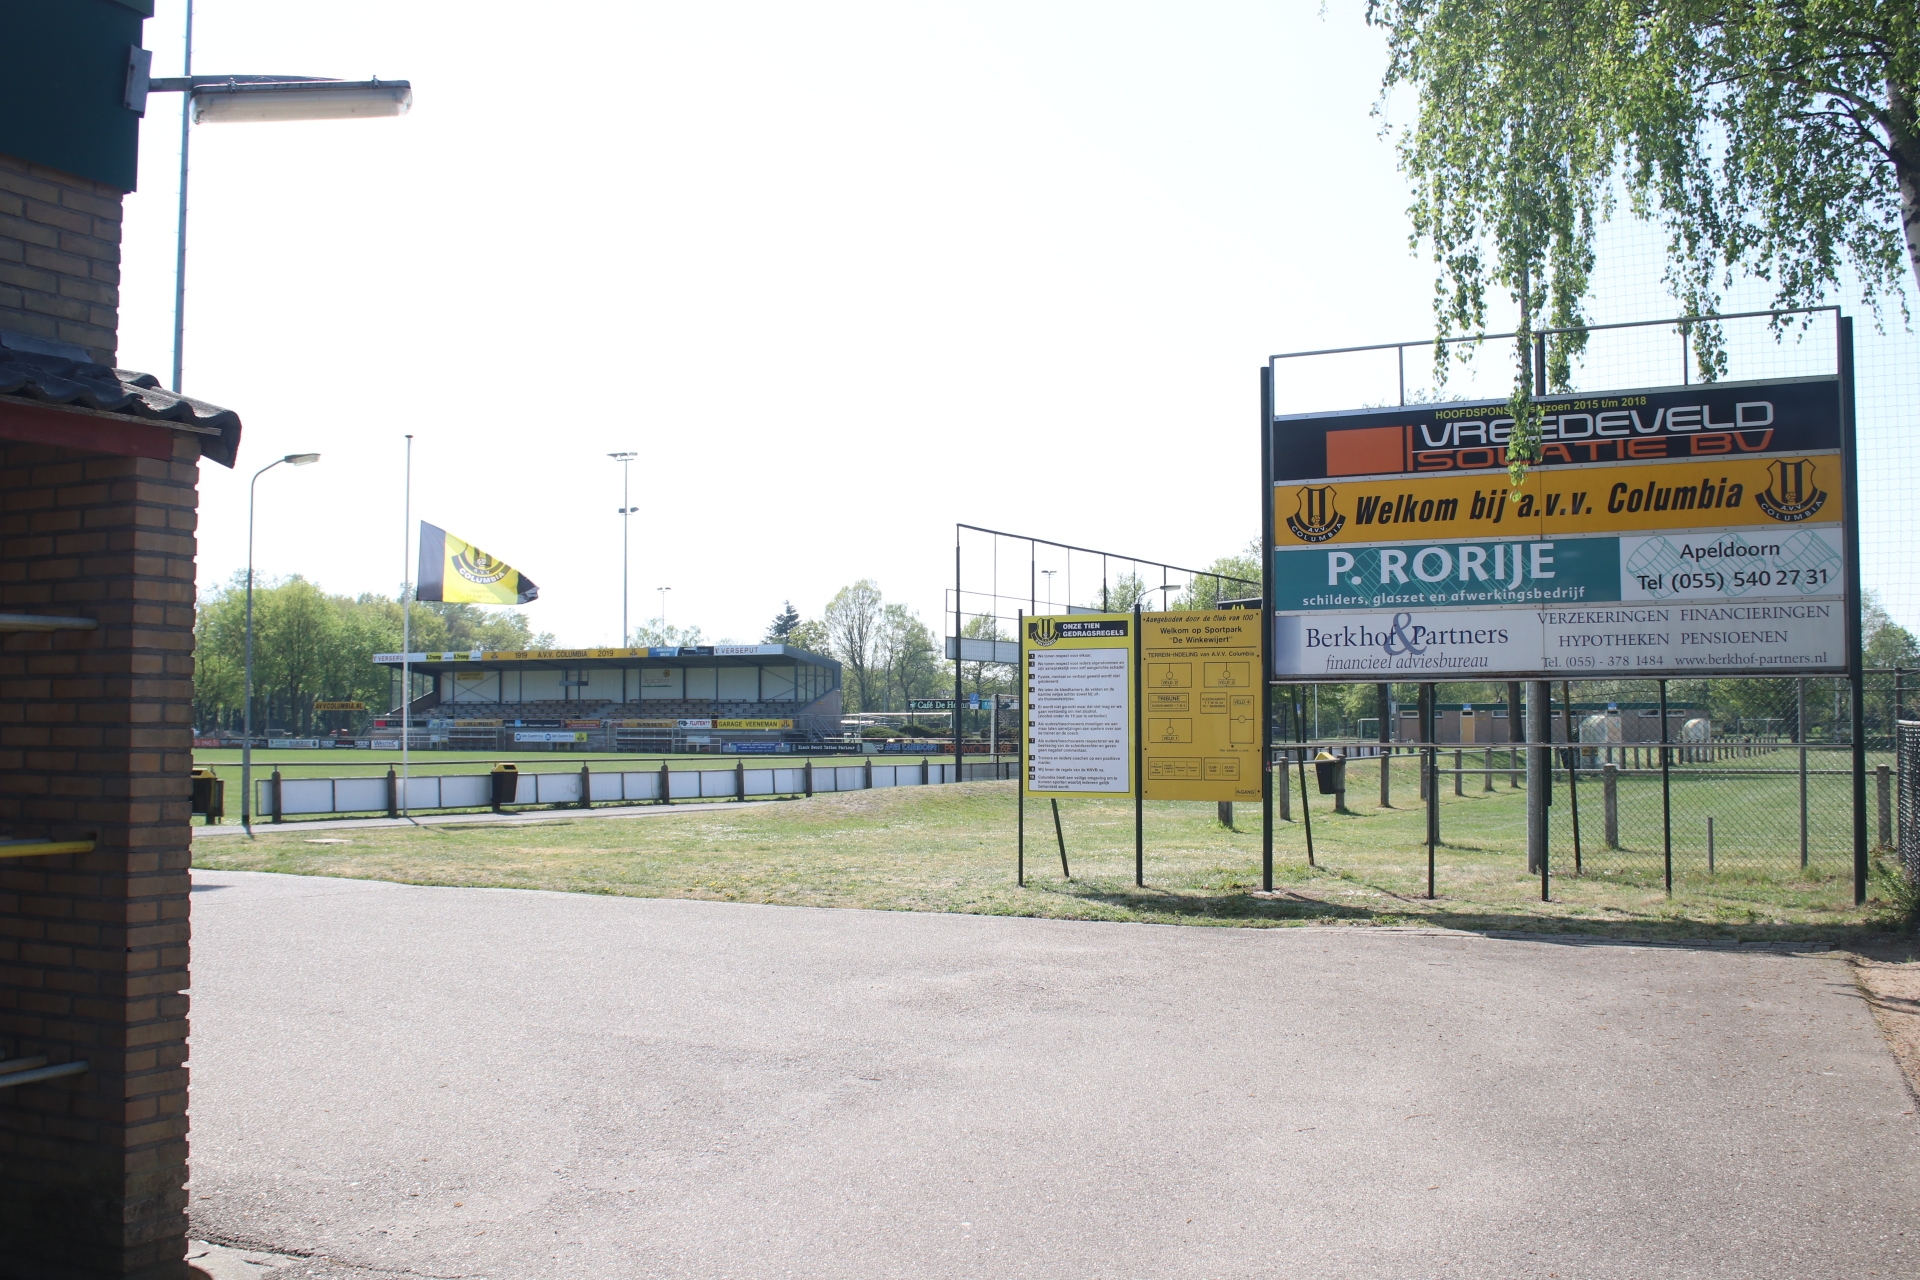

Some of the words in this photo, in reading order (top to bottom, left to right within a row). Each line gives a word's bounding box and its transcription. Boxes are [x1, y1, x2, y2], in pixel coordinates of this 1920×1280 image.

[1435, 407, 1519, 420] HOOFDSPONS
[1574, 399, 1599, 410] 2015
[1601, 398, 1619, 409] t/m
[1621, 396, 1647, 407] 2018
[1420, 400, 1774, 448] VREEDEVELD
[1690, 430, 1774, 455] BV
[1355, 492, 1458, 526] Welkom
[1469, 488, 1508, 524] bij
[1517, 491, 1593, 518] a.v.v.
[1607, 477, 1744, 514] Columbia
[1761, 500, 1823, 521] COLUMBIA
[1290, 522, 1343, 542] COLUMBIA
[1680, 541, 1780, 562] Apeldoorn
[459, 567, 505, 584] COLUMBIA
[1327, 551, 1362, 586] P.
[1380, 542, 1556, 591] RORIJE
[1637, 573, 1662, 590] Tel
[1672, 571, 1724, 593] (055)
[1734, 570, 1771, 587] 540
[1776, 569, 1800, 586] 27
[1805, 568, 1828, 585] 31
[1302, 593, 1369, 607] schilders,
[1373, 591, 1425, 607] glaszet
[1430, 592, 1446, 602] en
[1451, 586, 1585, 604] afwerkingsbedrijf
[1537, 609, 1669, 625] VERZEKERINGEN
[1680, 605, 1830, 621] FINANCIERINGEN
[1062, 629, 1124, 637] GEDRAGSREGELS
[1205, 626, 1242, 634] Sportpark
[1306, 623, 1397, 648] Berkhof
[1412, 624, 1509, 646] Partners
[1558, 633, 1670, 647] HYPOTHEKEN
[1681, 630, 1788, 645] PENSIOENEN
[515, 651, 528, 659] 1919
[556, 650, 588, 658] COLUMBIA
[597, 649, 614, 658] 2019
[720, 646, 759, 654] VERSEPUT
[1541, 656, 1561, 668] Tel.
[1565, 656, 1596, 669] (055)
[1607, 656, 1630, 667] 378
[1636, 655, 1664, 666] 1484
[1674, 651, 1828, 667] www.berkhof-partners.nl
[1325, 655, 1393, 674] financieel
[1396, 654, 1489, 670] adviesbureau
[917, 700, 933, 709] Café
[935, 701, 945, 709] De
[718, 720, 743, 728] GARAGE
[745, 720, 778, 728] VEENEMAN
